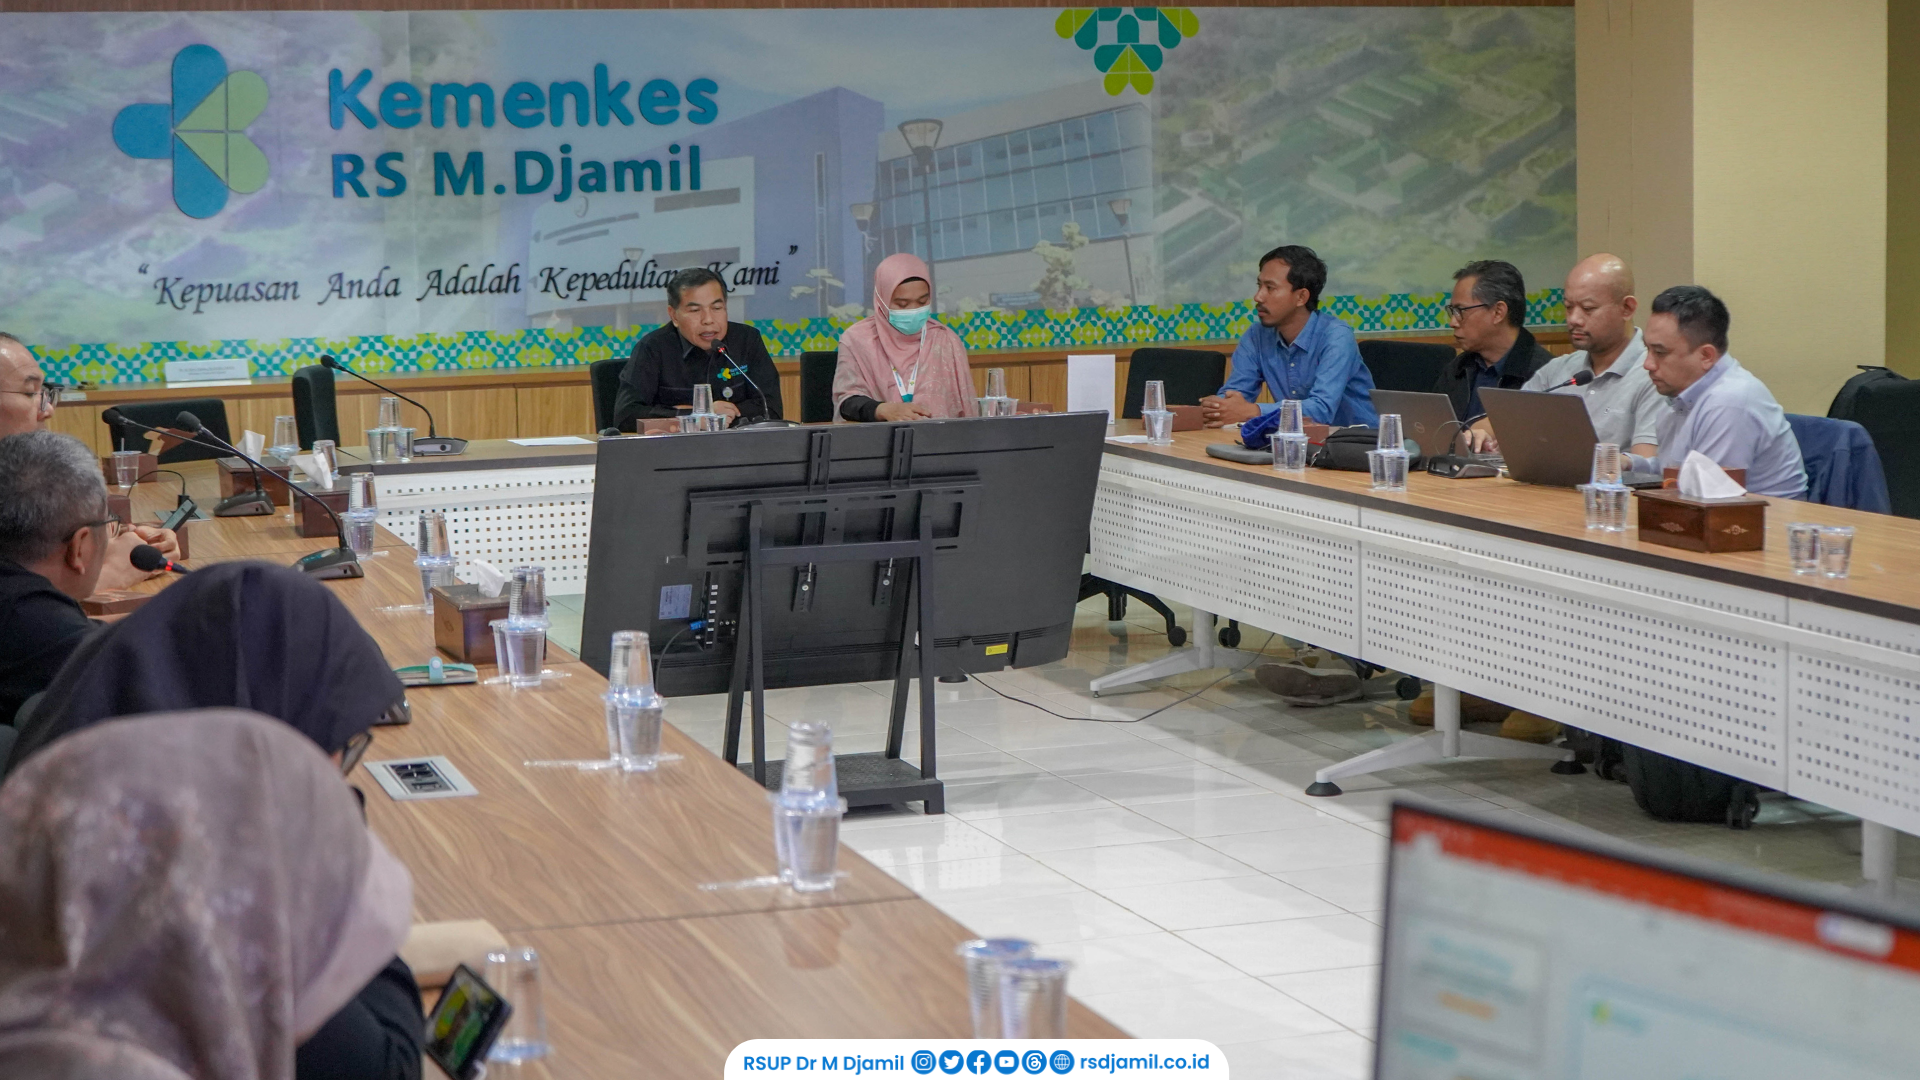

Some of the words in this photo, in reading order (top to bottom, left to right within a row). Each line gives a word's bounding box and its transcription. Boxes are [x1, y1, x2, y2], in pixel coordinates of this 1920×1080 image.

[328, 62, 720, 130] Kemenkes
[331, 151, 408, 198] RS
[433, 143, 702, 203] M.Djamil
[317, 265, 402, 306] Anda
[416, 262, 522, 302] Adalah
